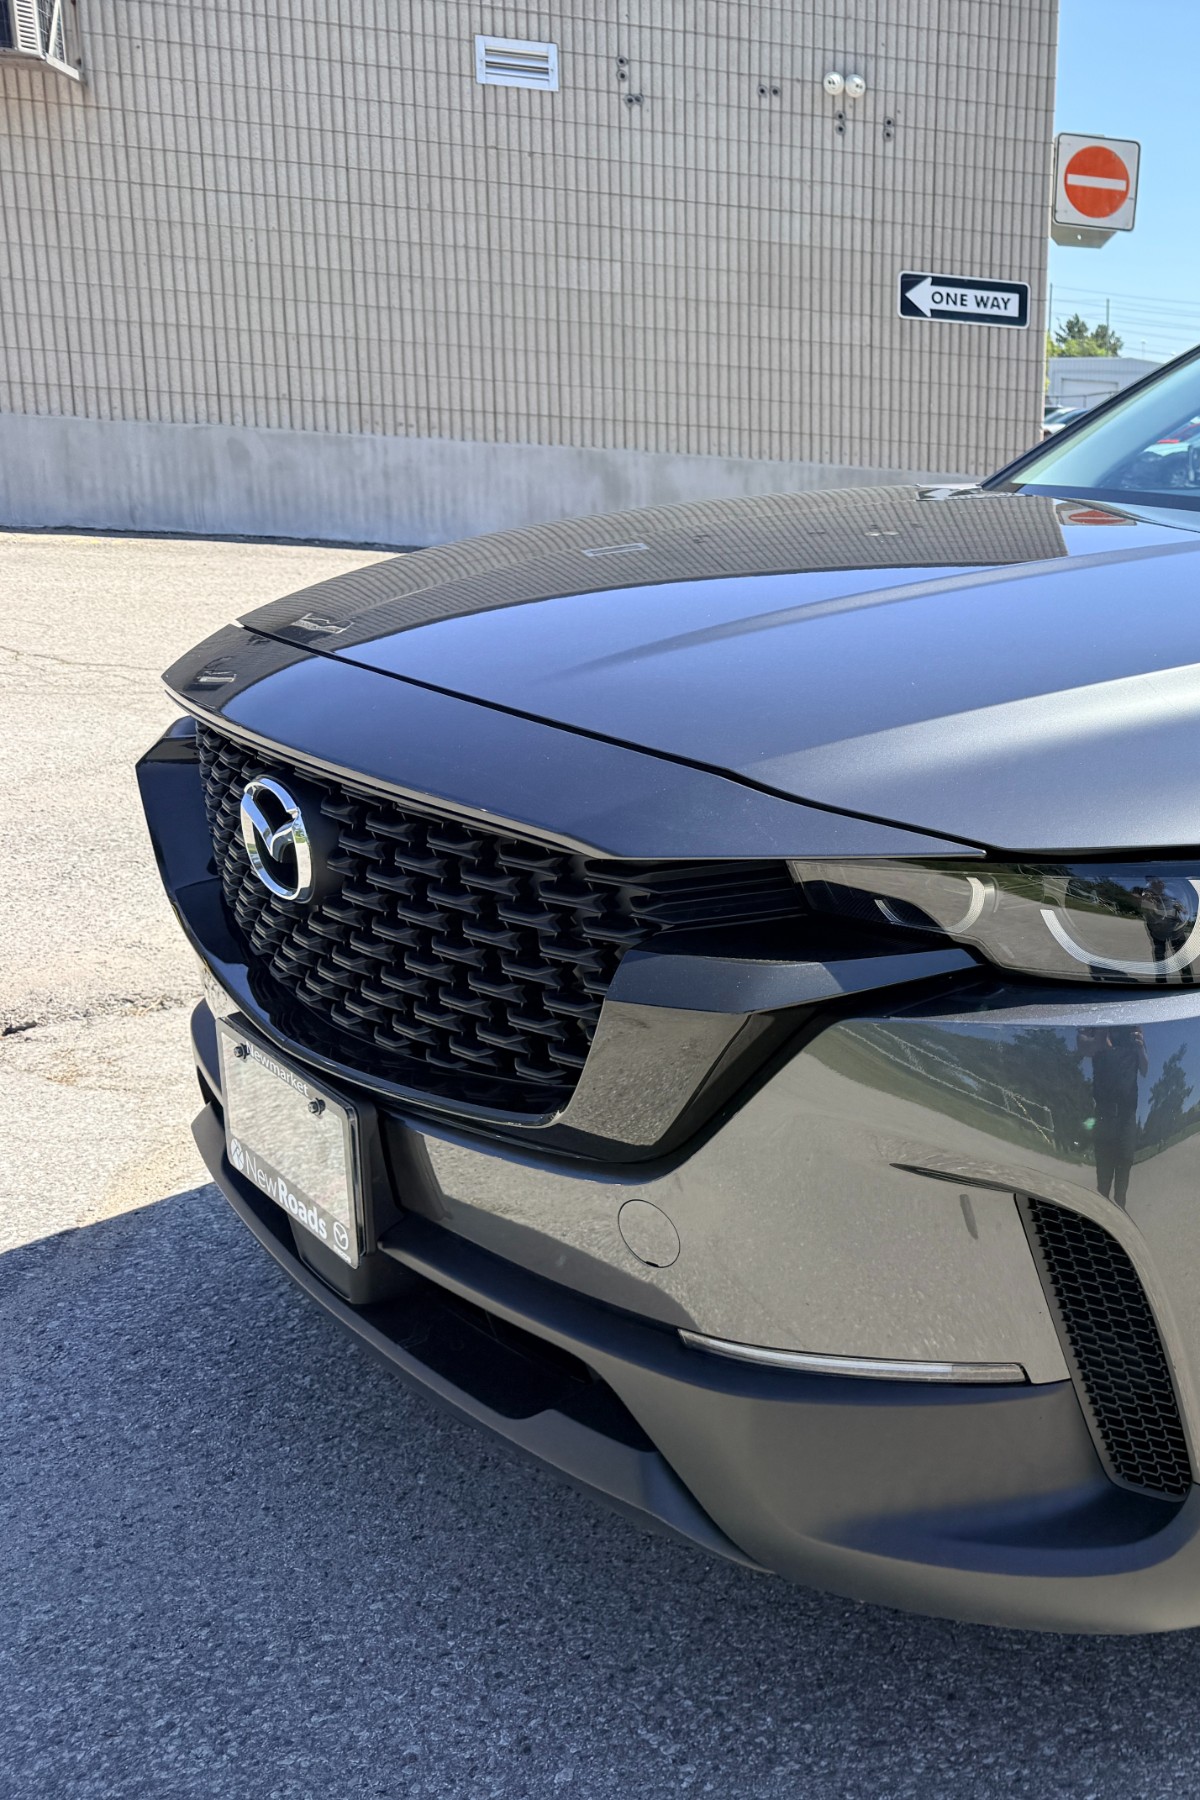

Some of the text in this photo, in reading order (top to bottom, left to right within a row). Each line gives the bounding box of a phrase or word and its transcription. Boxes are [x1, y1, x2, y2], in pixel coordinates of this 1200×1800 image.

[931, 291, 1011, 310] ONE WAY
[245, 1040, 309, 1097] Newmarket
[245, 1150, 328, 1240] NewRoads
